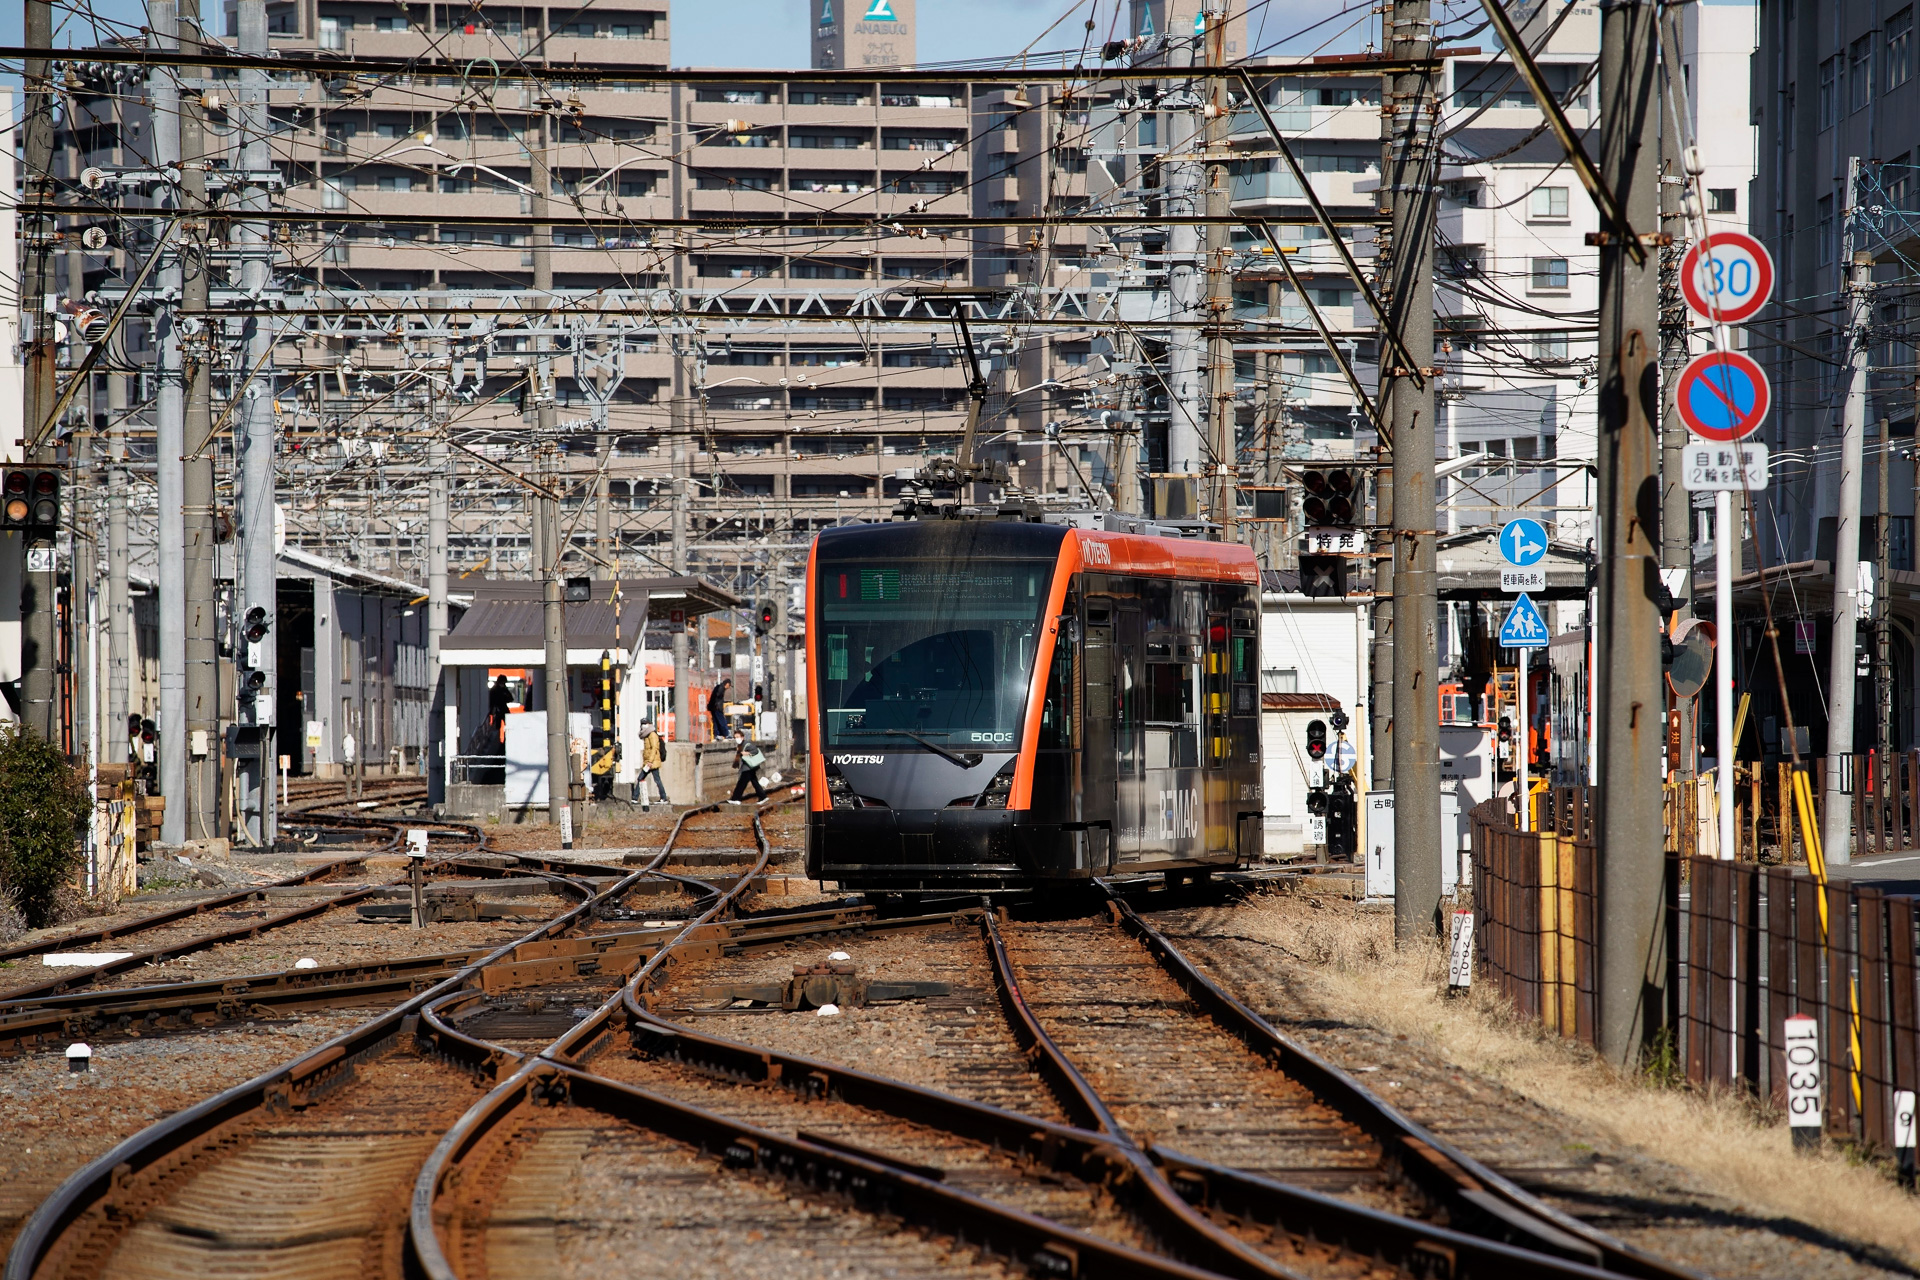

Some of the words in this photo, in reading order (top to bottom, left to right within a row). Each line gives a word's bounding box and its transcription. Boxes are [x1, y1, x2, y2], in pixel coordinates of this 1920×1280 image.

[854, 22, 907, 35] ANABUKI
[1703, 257, 1752, 297] 30
[1696, 450, 1754, 466] 自動車
[1316, 533, 1354, 548] 特発
[30, 550, 54, 569] 34
[872, 573, 884, 599] 1
[1503, 573, 1543, 585] 軽車両を除く
[971, 732, 1014, 742] 5003
[832, 754, 885, 765] IYOTETSU
[1374, 799, 1394, 809] 古町
[1159, 788, 1198, 840] BEMAC
[1313, 819, 1324, 841] 誘導
[1788, 1029, 1820, 1115] 1035
